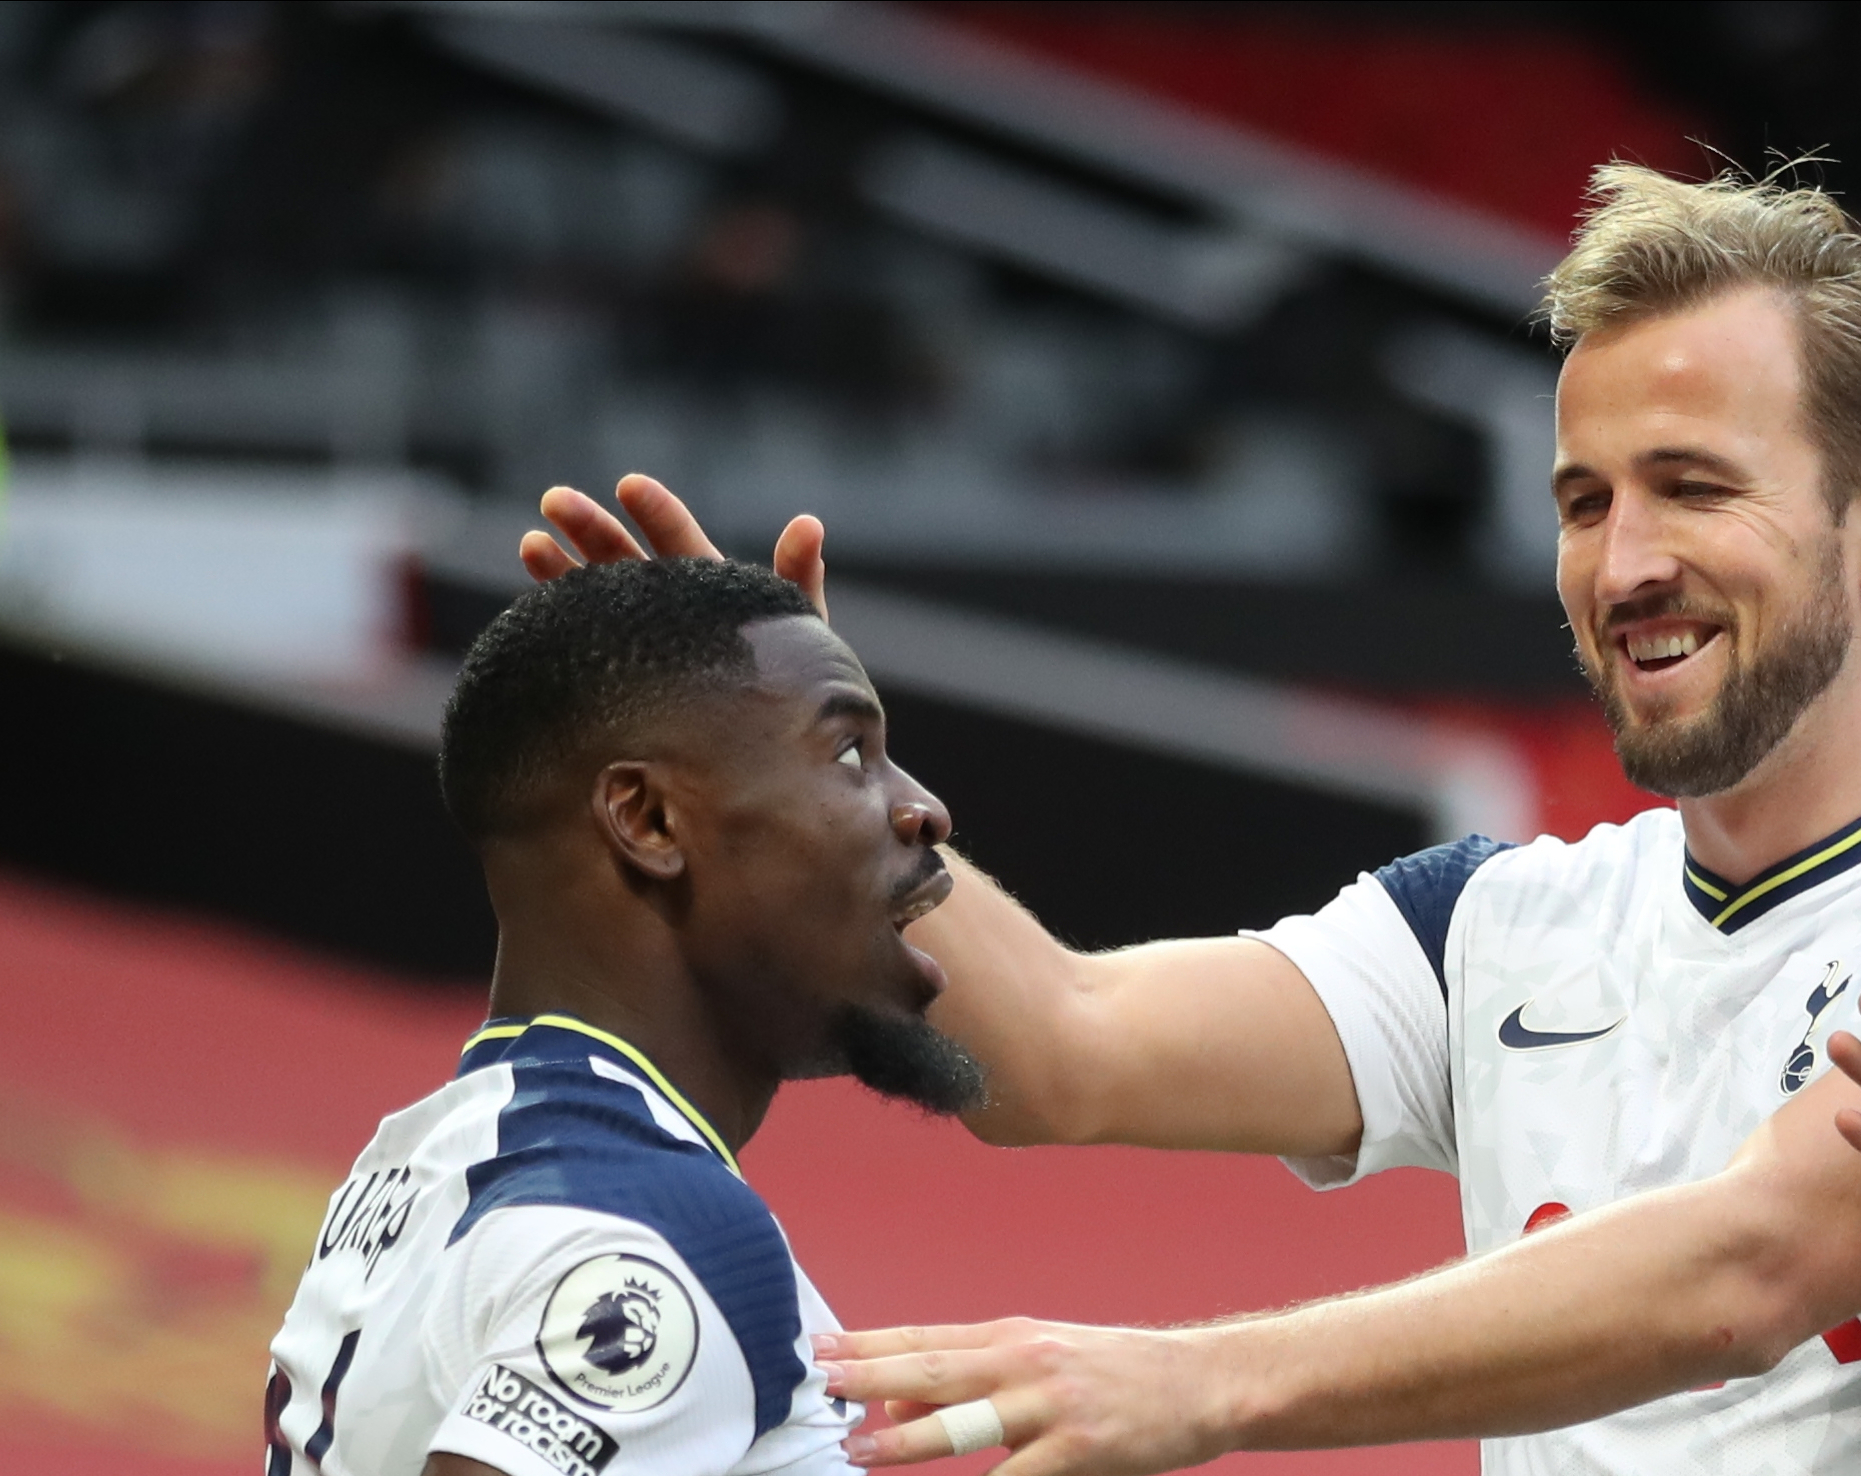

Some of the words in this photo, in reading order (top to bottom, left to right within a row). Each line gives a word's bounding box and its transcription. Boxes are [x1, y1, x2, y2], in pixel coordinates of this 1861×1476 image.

[574, 1372, 624, 1398] Premier
[626, 1362, 670, 1396] League
[461, 1389, 507, 1423] for
[476, 1363, 522, 1402] No
[517, 1390, 604, 1462] room
